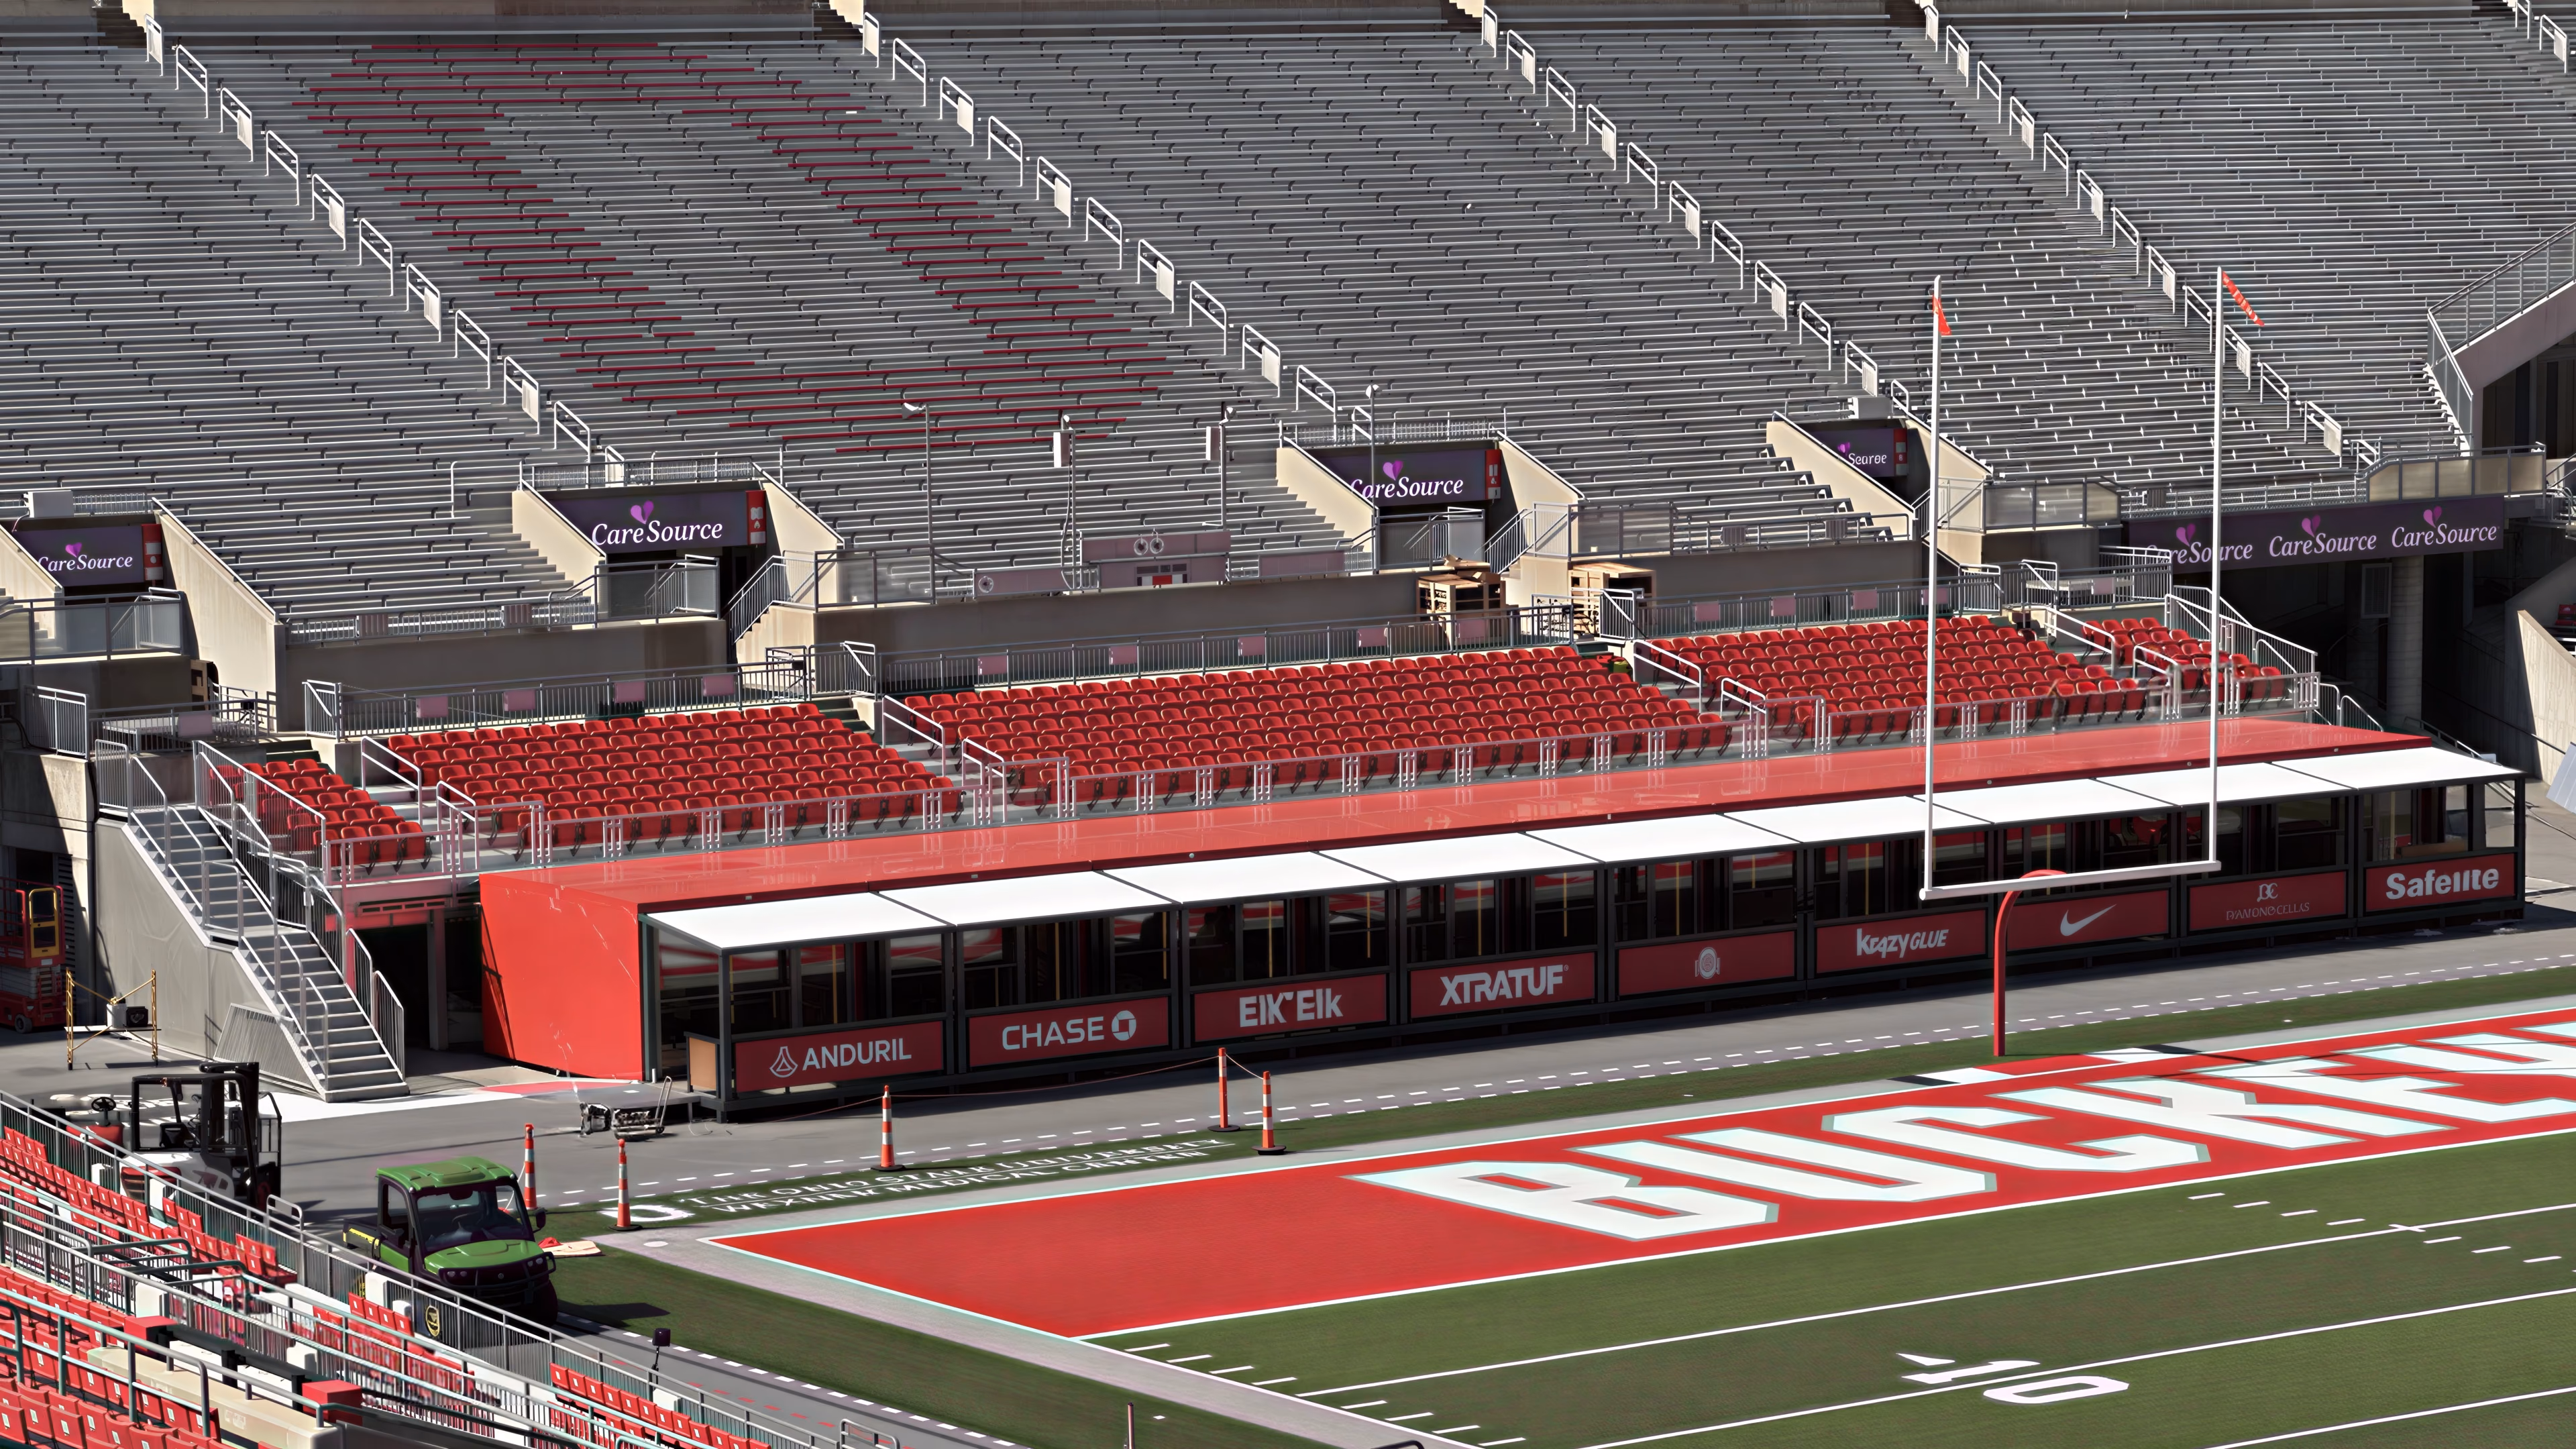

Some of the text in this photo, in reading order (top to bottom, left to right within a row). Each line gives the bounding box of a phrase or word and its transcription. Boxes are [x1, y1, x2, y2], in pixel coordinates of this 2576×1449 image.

[592, 520, 723, 545] CareSource
[2269, 533, 2377, 557] CareSource
[2392, 523, 2497, 548] CareSource
[2147, 541, 2253, 565] reSorce
[1910, 929, 1949, 950] GLUE
[1002, 1016, 1105, 1051] CHASE
[802, 1038, 912, 1071] ANDURIL
